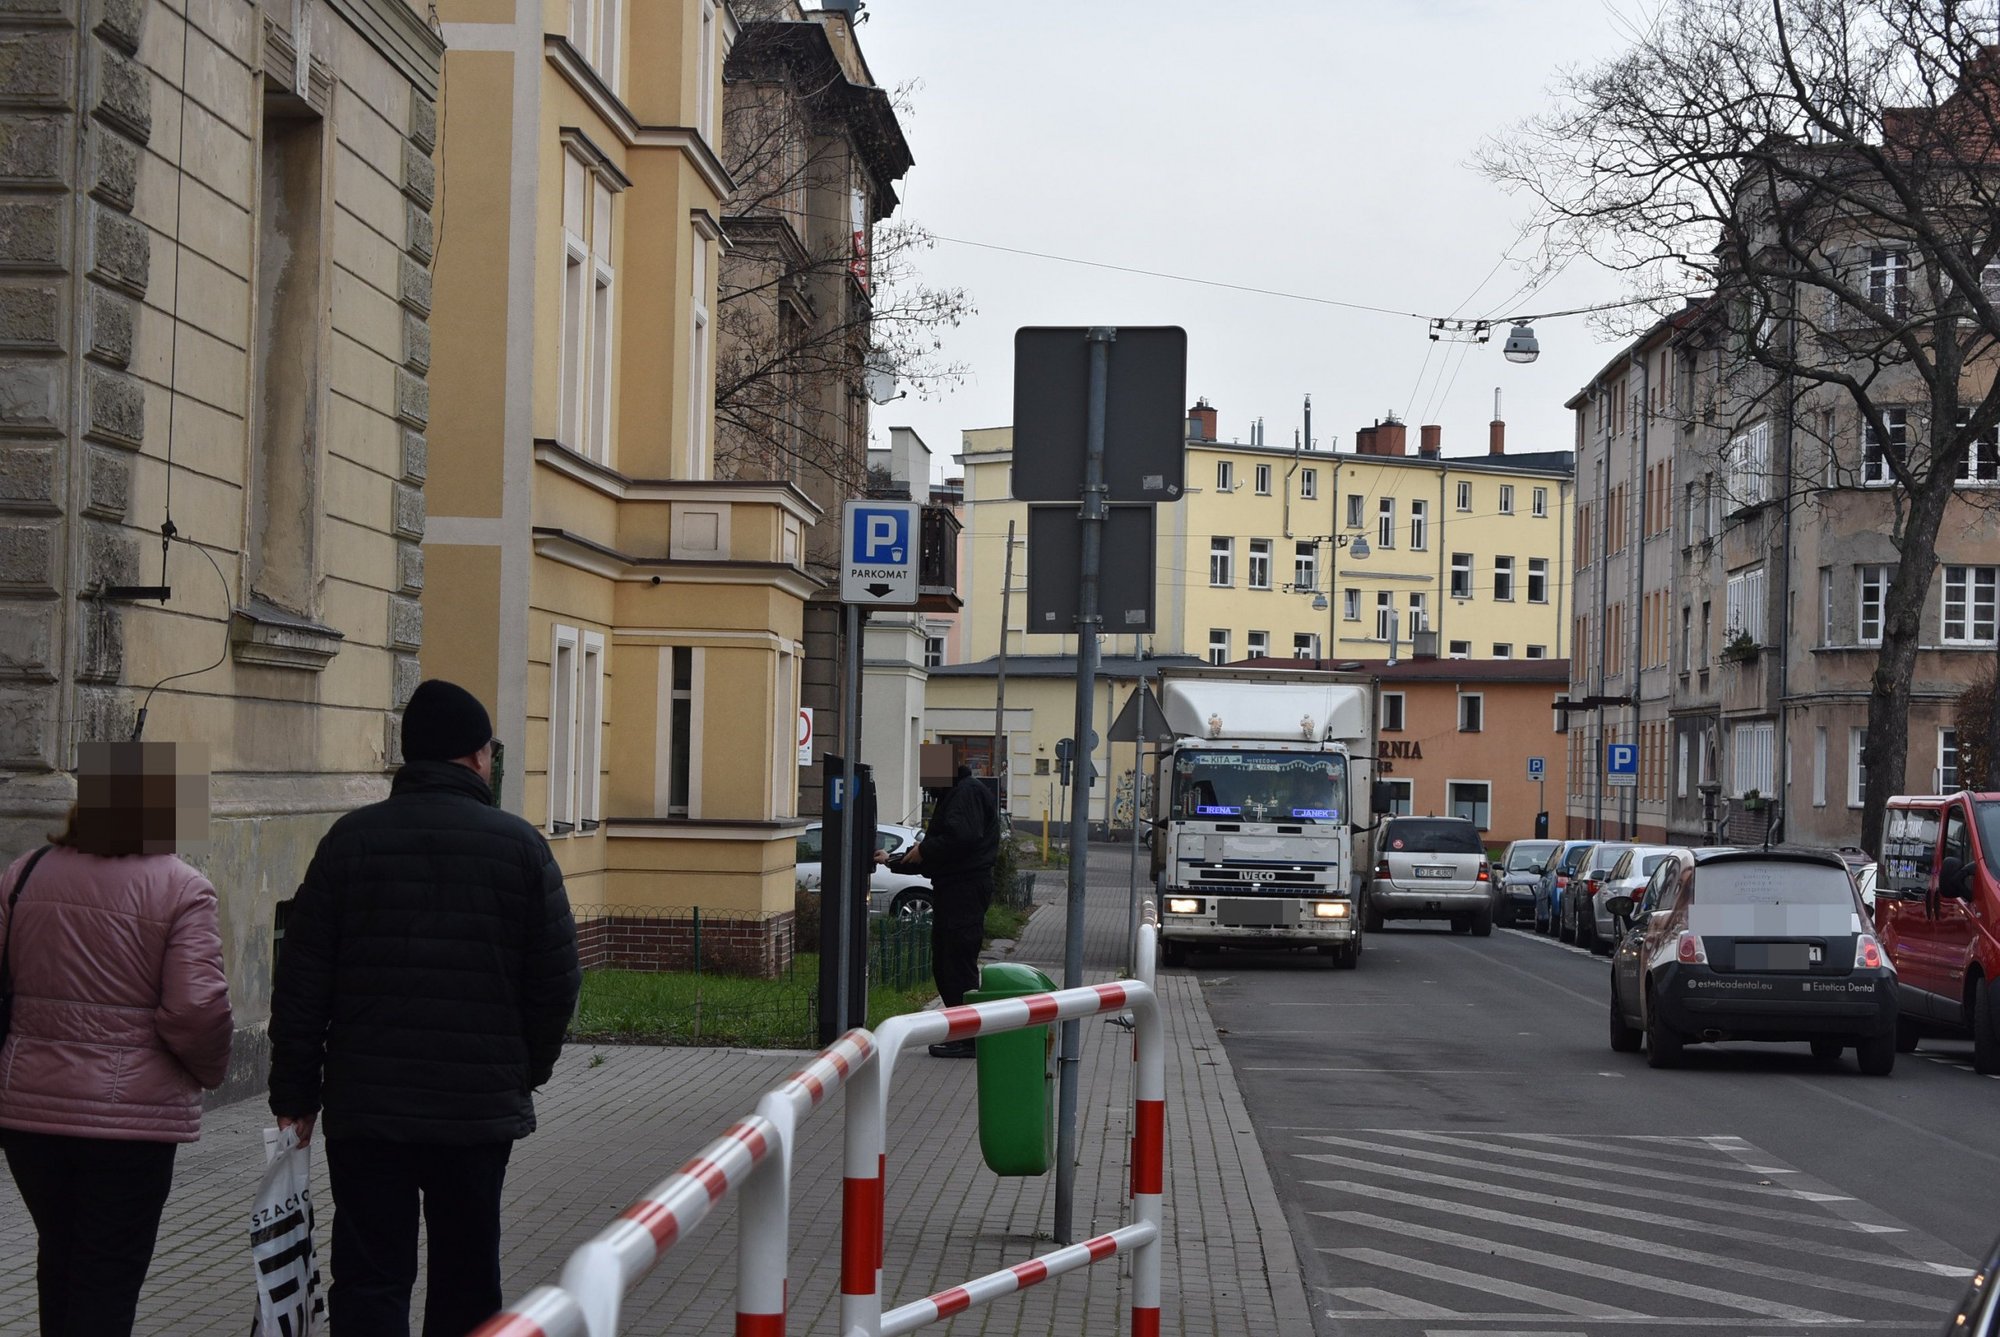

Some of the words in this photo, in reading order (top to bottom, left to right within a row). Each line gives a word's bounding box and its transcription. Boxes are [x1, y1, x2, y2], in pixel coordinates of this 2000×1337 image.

[866, 515, 897, 557] P
[851, 569, 908, 579] PARKOMAT
[1377, 740, 1423, 759] RNIA
[1211, 756, 1231, 764] KITA
[1614, 747, 1632, 770] P
[1377, 761, 1394, 773] ER
[1532, 760, 1541, 771] P
[1206, 806, 1232, 815] IRENA
[1301, 809, 1330, 817] JANEK
[1540, 816, 1547, 824] P
[1239, 871, 1276, 880] IVECO
[1697, 979, 1773, 990] esteticadental.eu
[1813, 982, 1846, 992] Estetica
[1848, 983, 1875, 993] Dental
